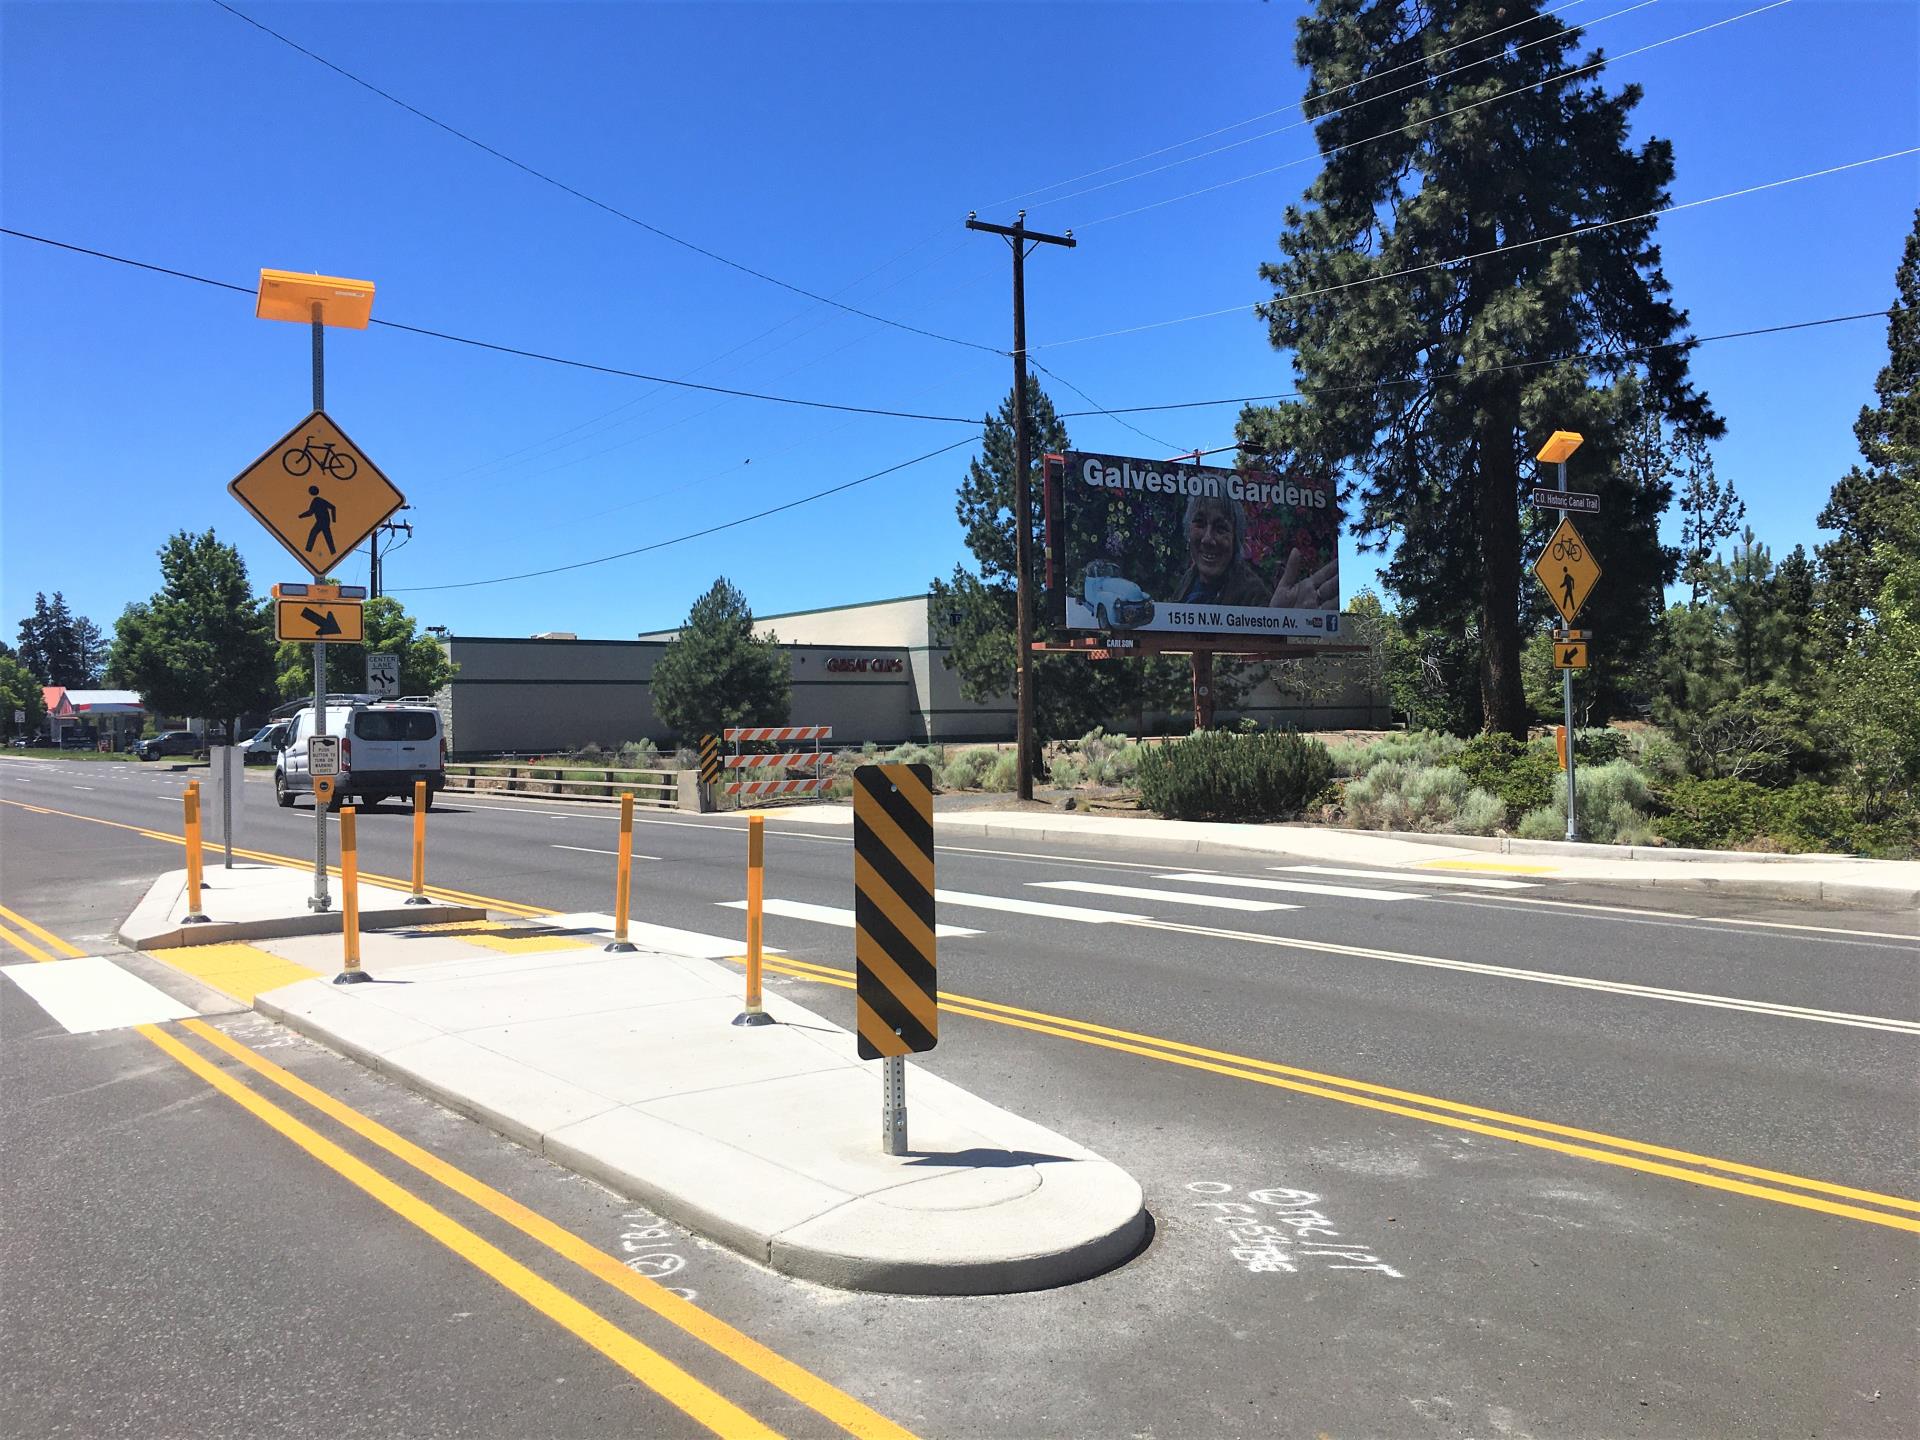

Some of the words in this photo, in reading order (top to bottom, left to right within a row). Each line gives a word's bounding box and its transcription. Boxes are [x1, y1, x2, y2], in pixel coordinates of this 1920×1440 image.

[1083, 458, 1219, 498] Galveston
[1226, 474, 1327, 509] Gardens
[1547, 494, 1568, 506] Historic
[1568, 496, 1585, 508] Canal
[1586, 498, 1598, 509] Trail
[1167, 611, 1195, 625] 1515
[1198, 612, 1223, 626] N.W.
[1226, 613, 1280, 628] Galveston
[1282, 615, 1299, 629] Av.
[1106, 639, 1134, 649] CARLSON
[374, 688, 393, 696] ONLY
